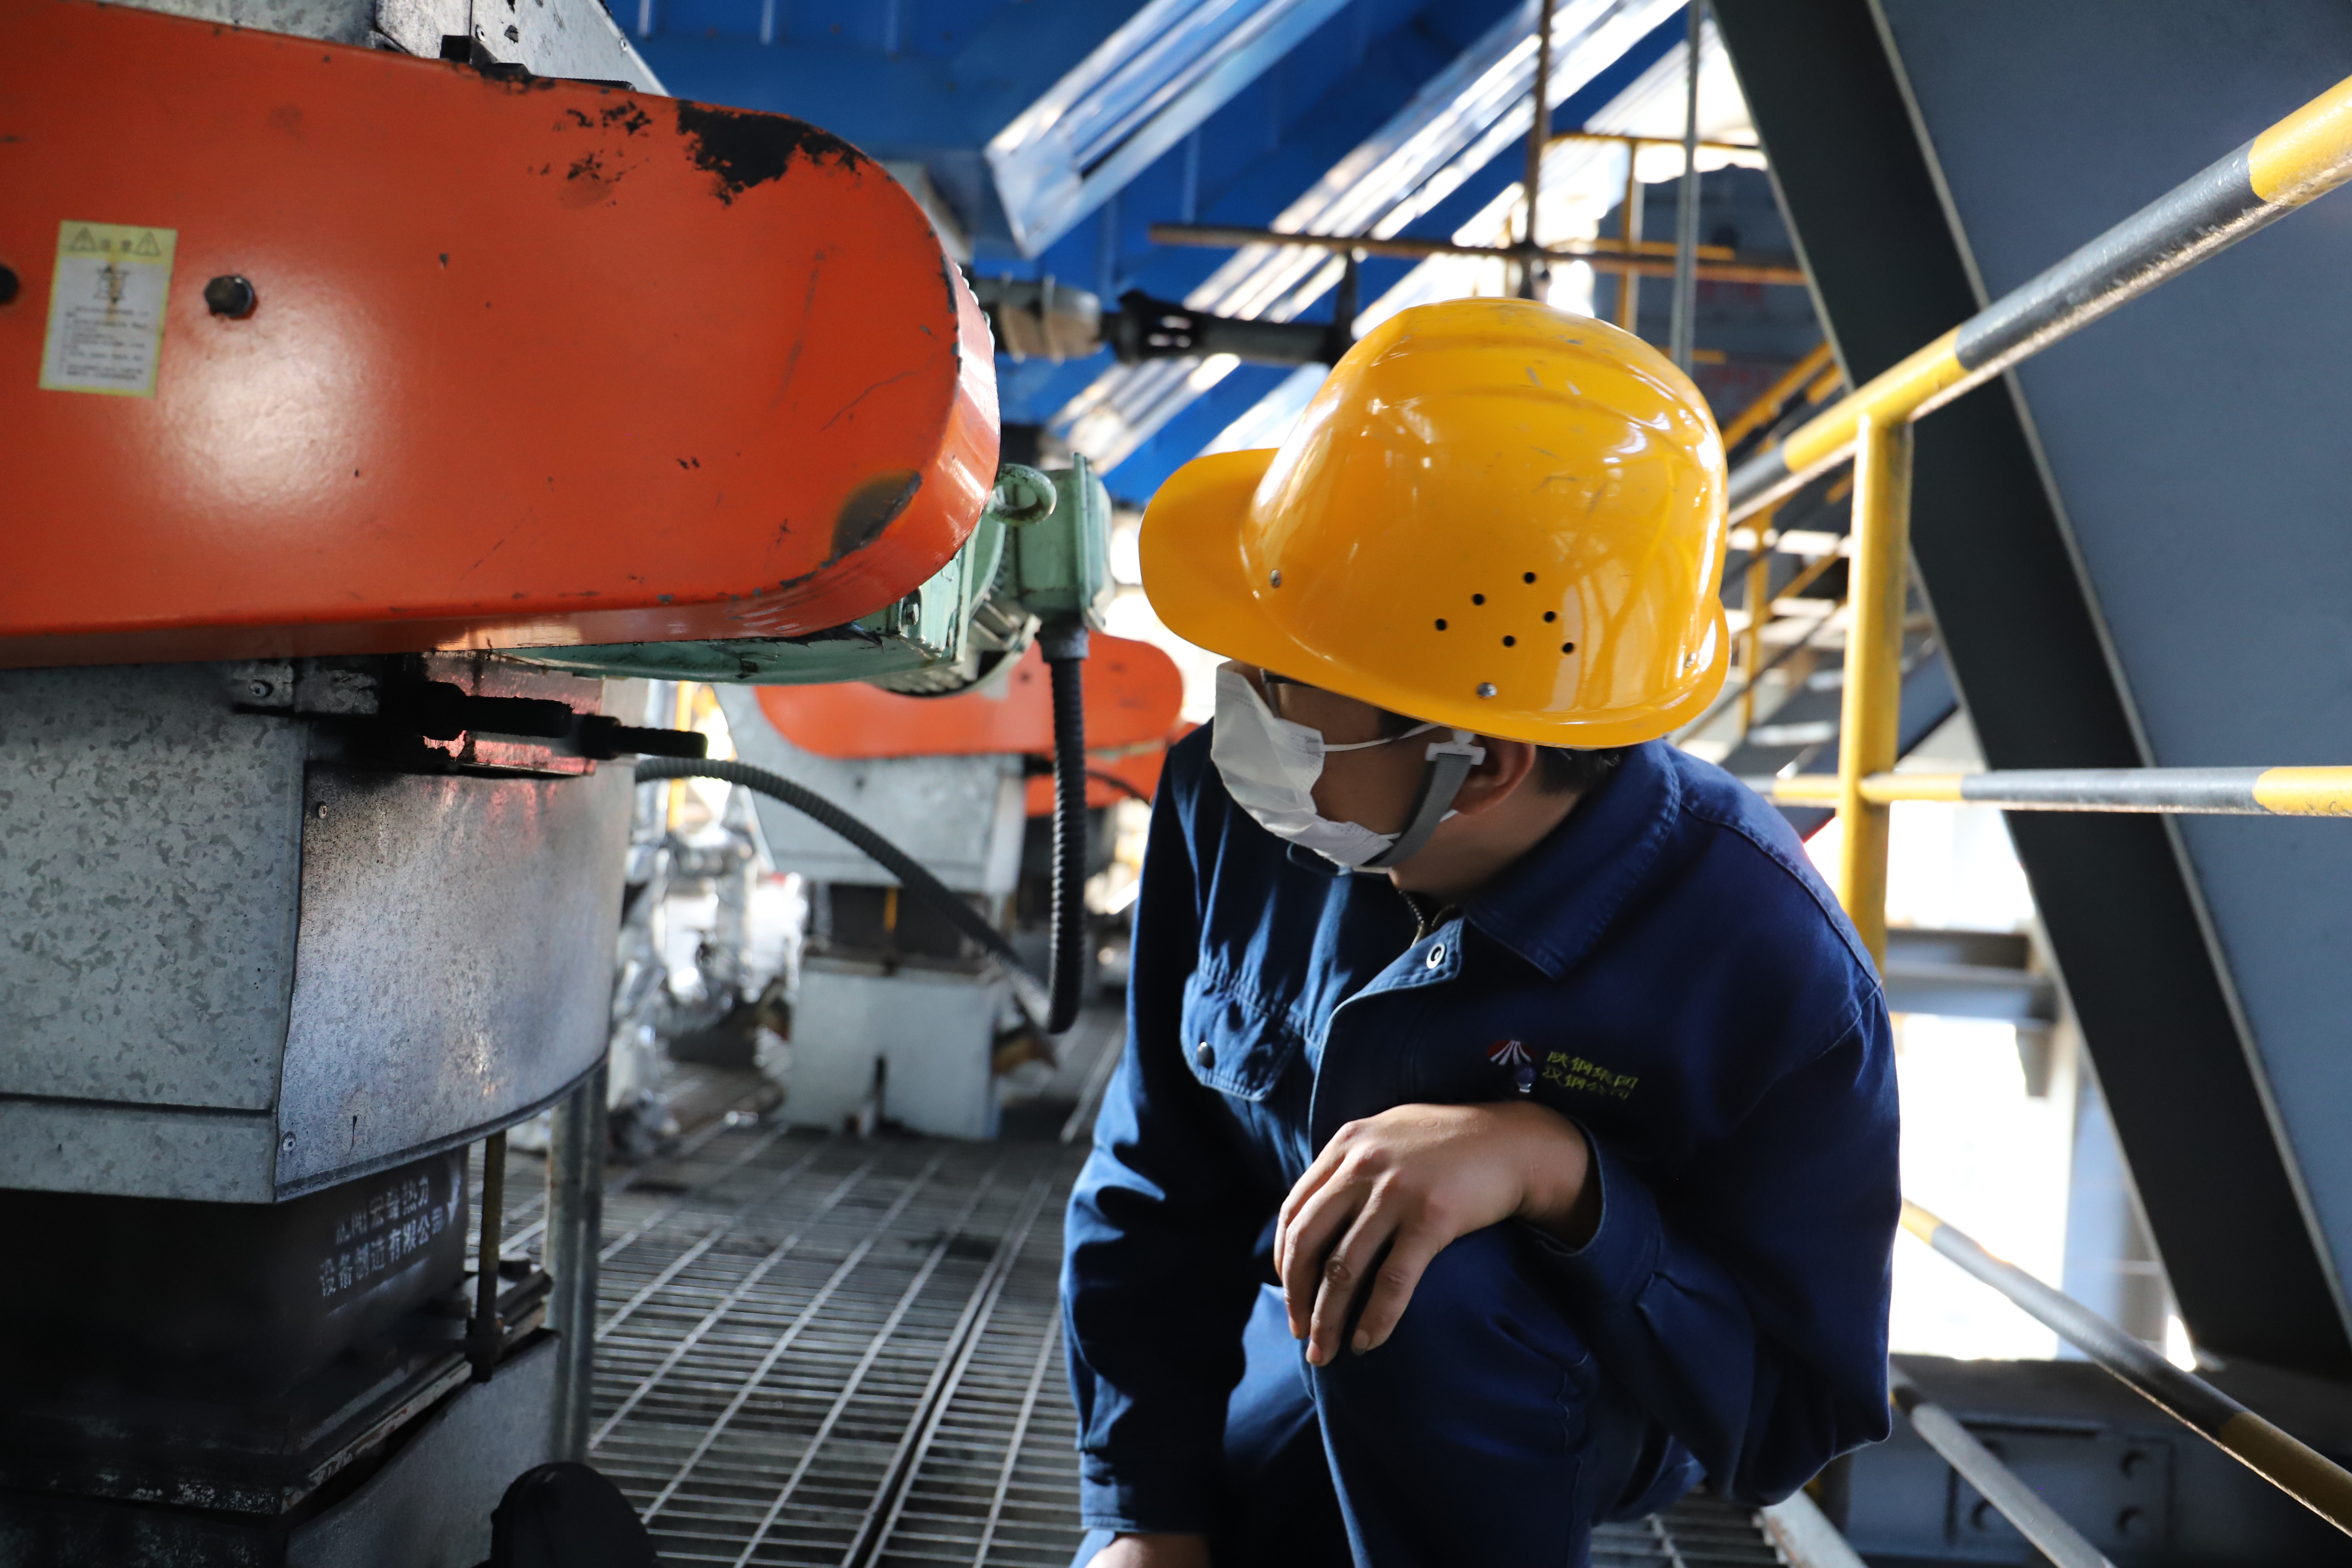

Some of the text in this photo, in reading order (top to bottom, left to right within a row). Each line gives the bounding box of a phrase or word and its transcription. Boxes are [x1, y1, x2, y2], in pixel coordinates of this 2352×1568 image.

[319, 1206, 444, 1297] 设备制造有限公司
